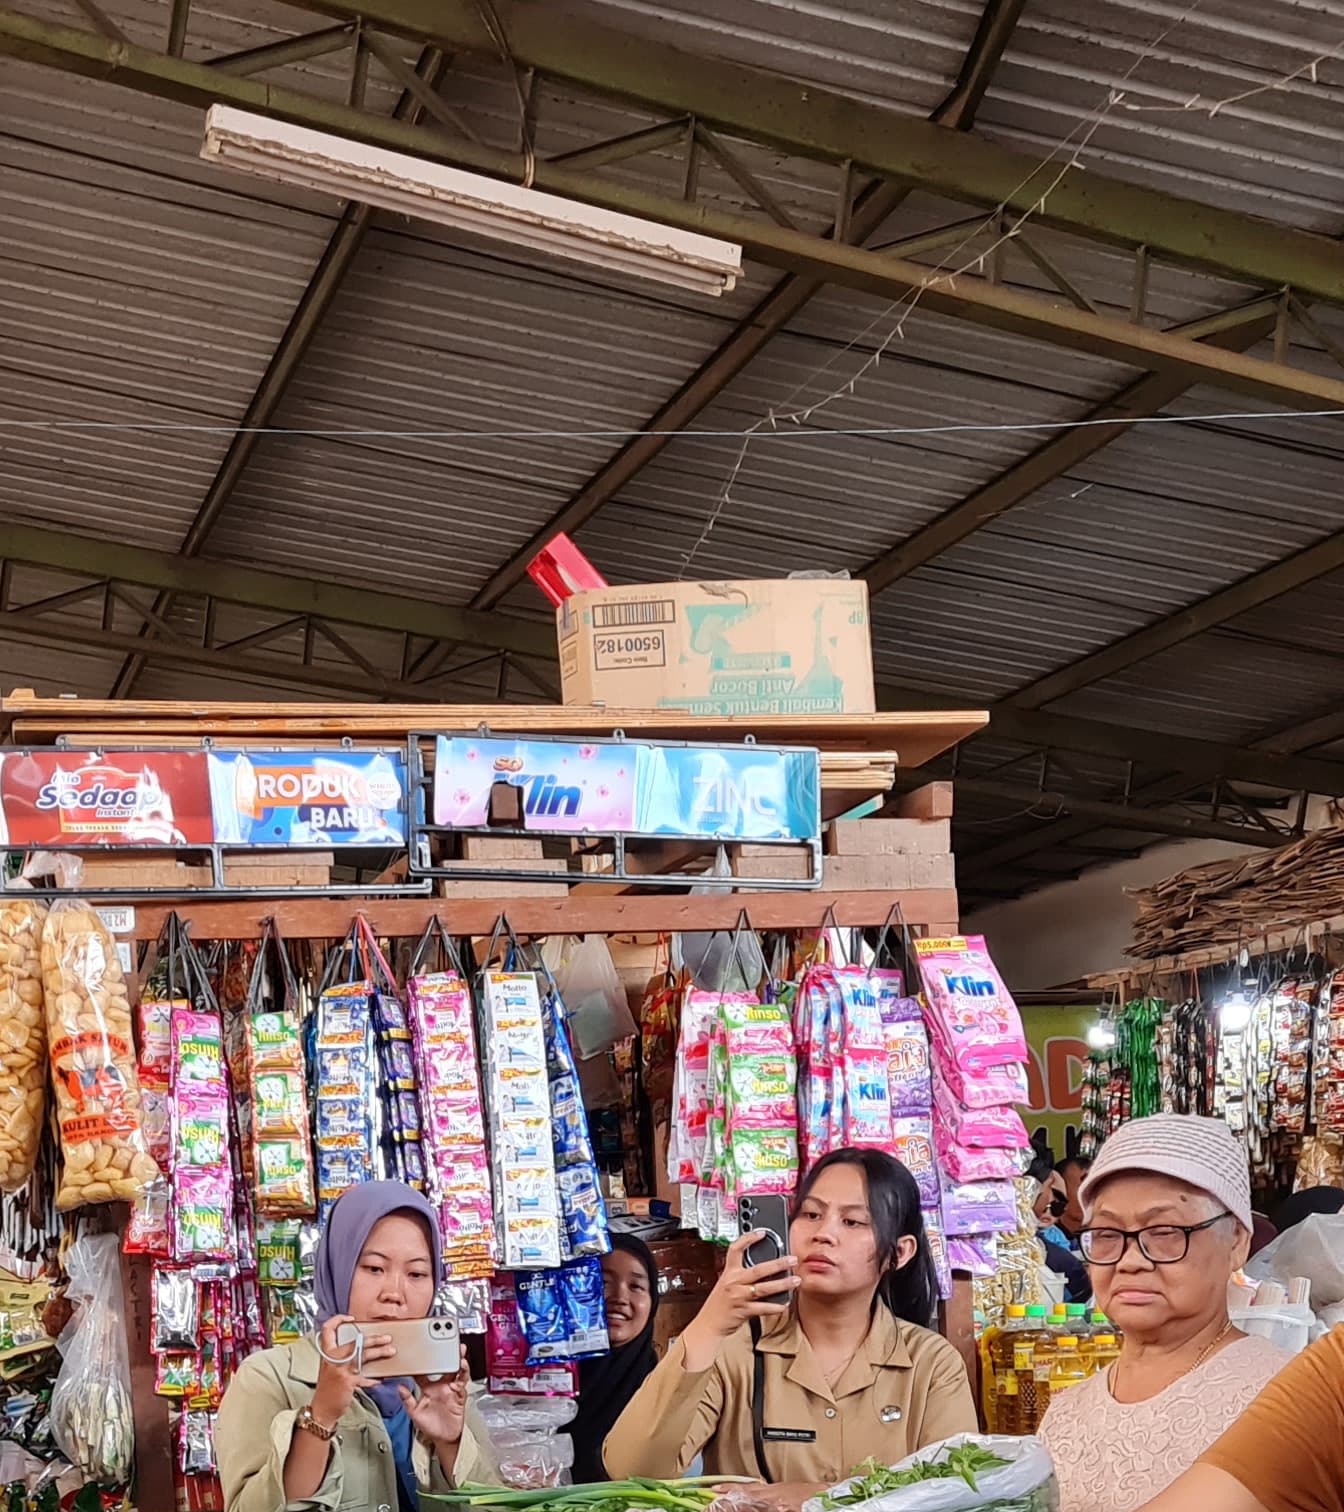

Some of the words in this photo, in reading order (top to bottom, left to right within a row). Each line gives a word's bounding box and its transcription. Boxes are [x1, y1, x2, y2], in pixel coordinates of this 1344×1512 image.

[596, 636, 661, 652] 6500182
[710, 679, 758, 696] Bocor
[761, 679, 795, 696] Anti
[723, 699, 780, 714] Bentuk
[242, 773, 362, 800] PRODUK
[693, 776, 777, 816] ZINC
[310, 807, 375, 829] BARU
[943, 974, 996, 997] Klin
[745, 1006, 781, 1020] Rinso
[179, 1042, 220, 1059] Rinso
[751, 1080, 787, 1094] Rinso
[754, 1151, 788, 1169] Rinso
[183, 1212, 222, 1229] Rinso
[259, 1244, 296, 1261] Rinso
